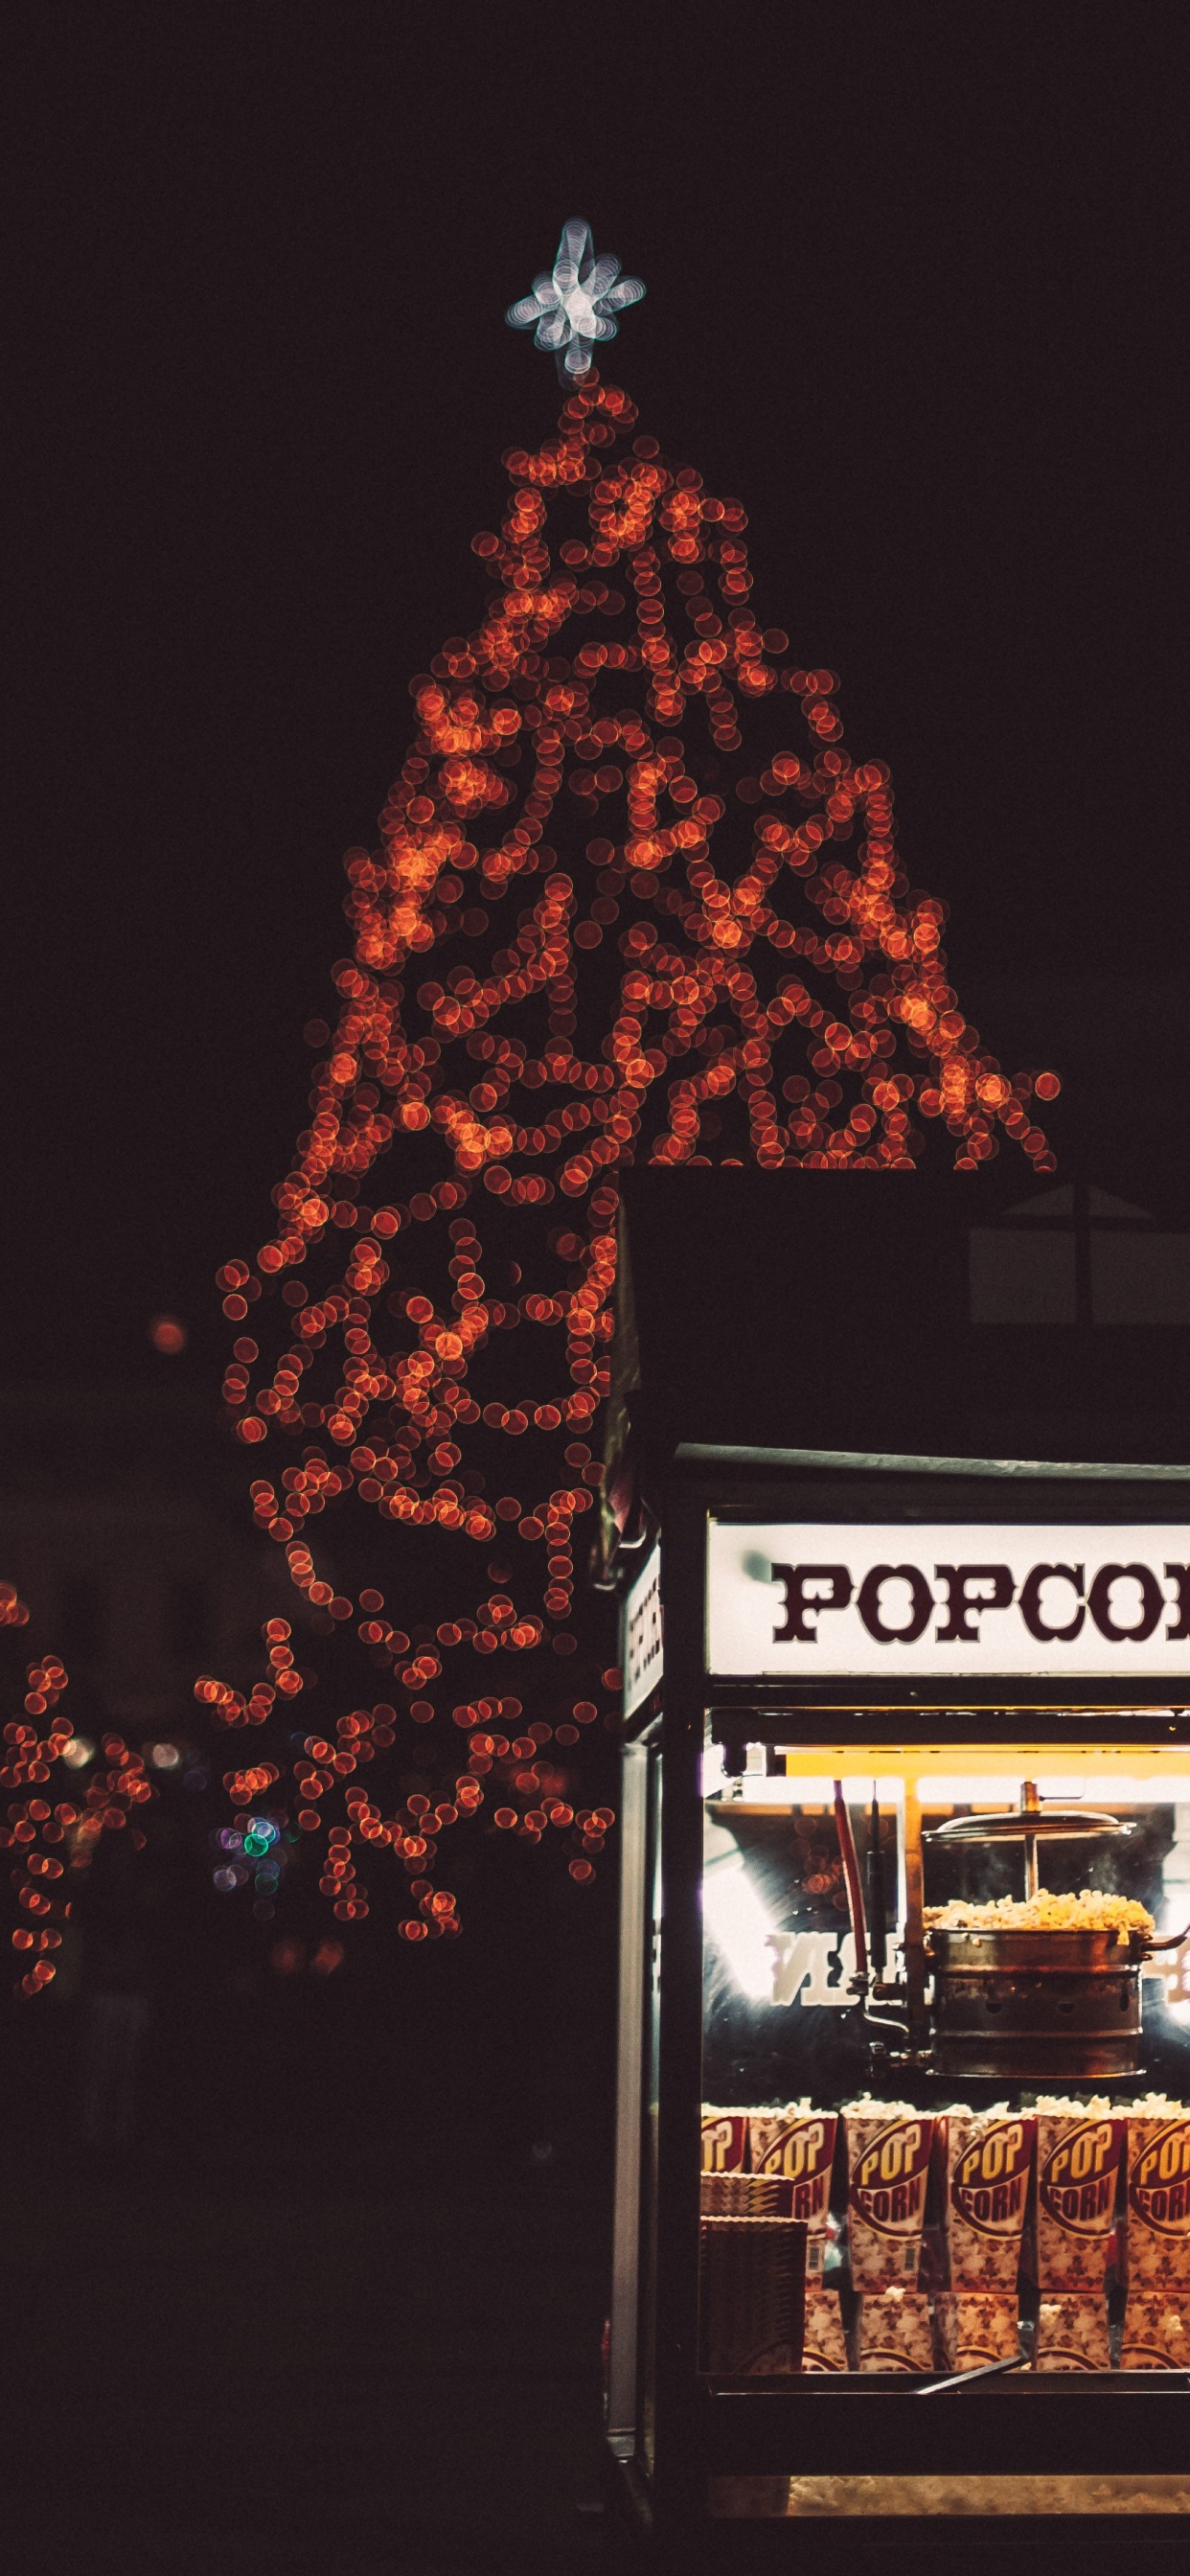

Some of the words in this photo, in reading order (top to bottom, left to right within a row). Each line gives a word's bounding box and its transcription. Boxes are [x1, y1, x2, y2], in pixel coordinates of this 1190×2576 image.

[861, 2124, 921, 2186] POP
[962, 2124, 1023, 2184] POP
[1051, 2124, 1112, 2183] POP
[794, 2174, 824, 2220] RN
[859, 2173, 921, 2222] CORN
[961, 2174, 1022, 2222] CORN
[1050, 2174, 1111, 2221] CORN
